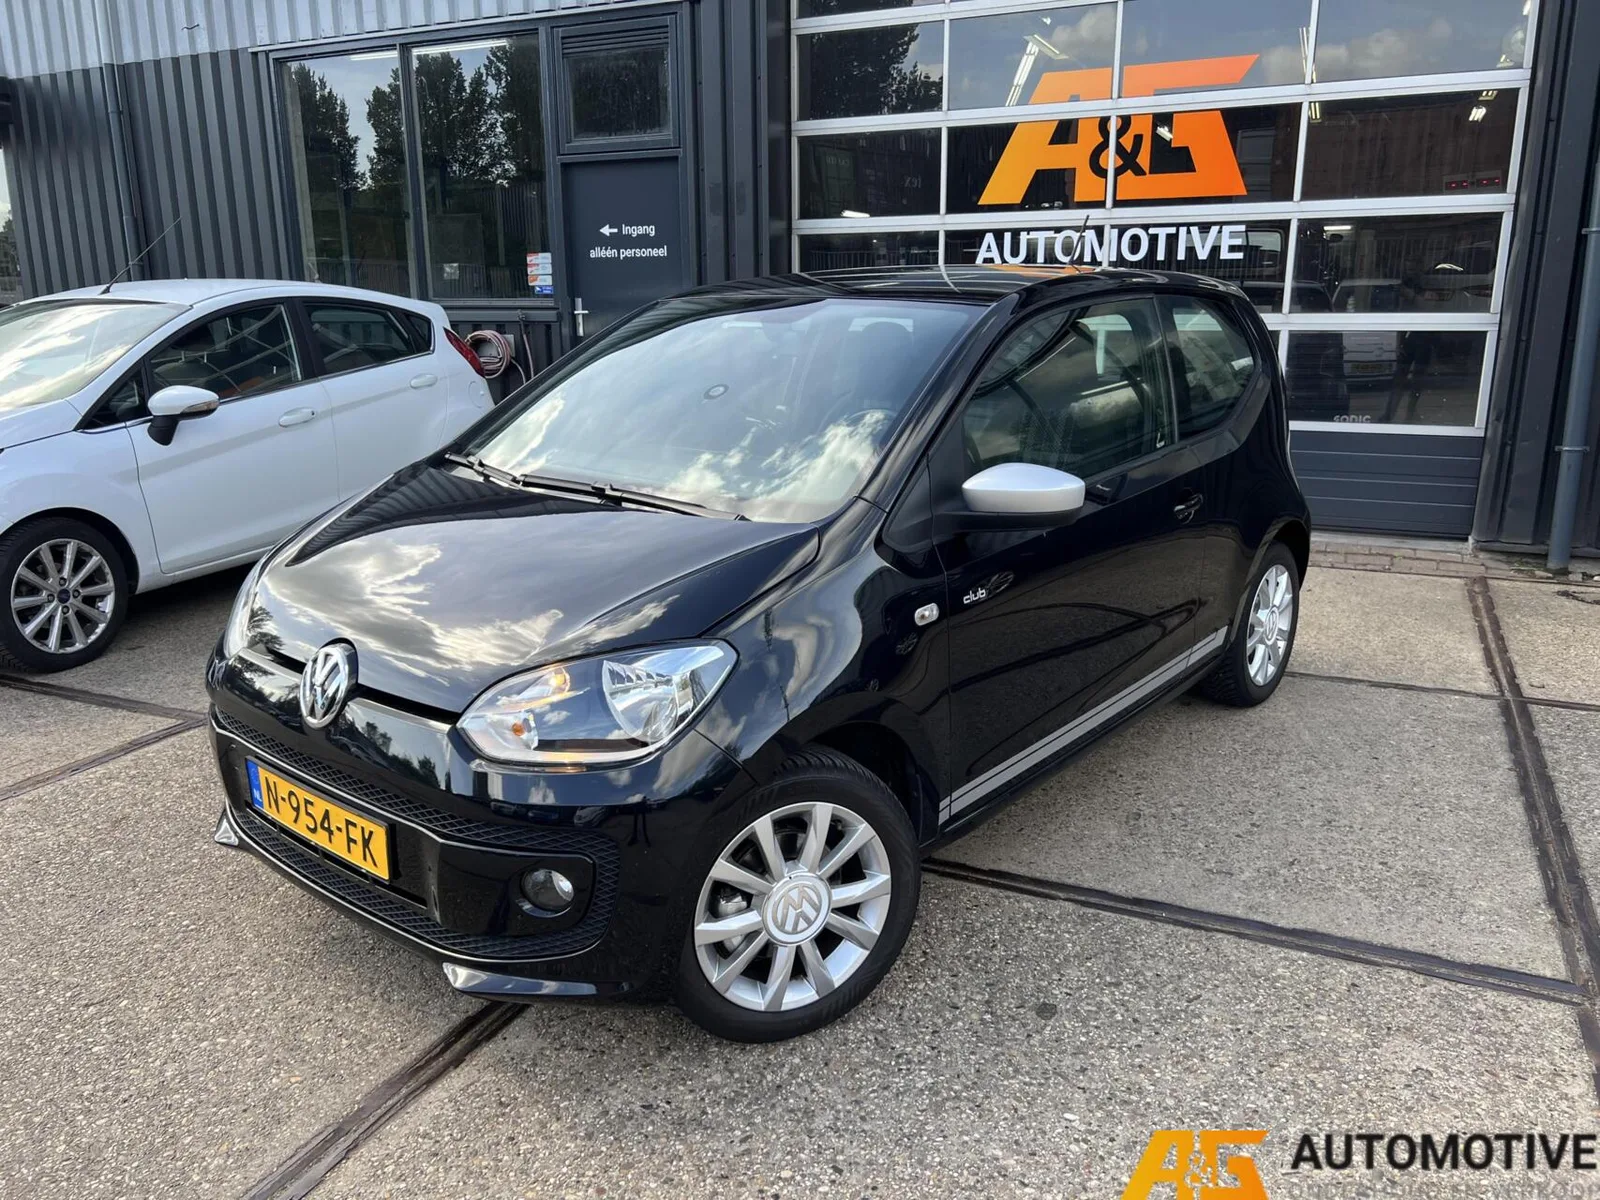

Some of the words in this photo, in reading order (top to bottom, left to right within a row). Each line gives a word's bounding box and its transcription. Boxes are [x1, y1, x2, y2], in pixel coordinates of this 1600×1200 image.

[622, 224, 656, 237] Ingang
[620, 245, 667, 260] personeel
[975, 225, 1246, 265] AUTOMOTIVE
[963, 587, 986, 604] club
[264, 776, 379, 869] N-954-FK
